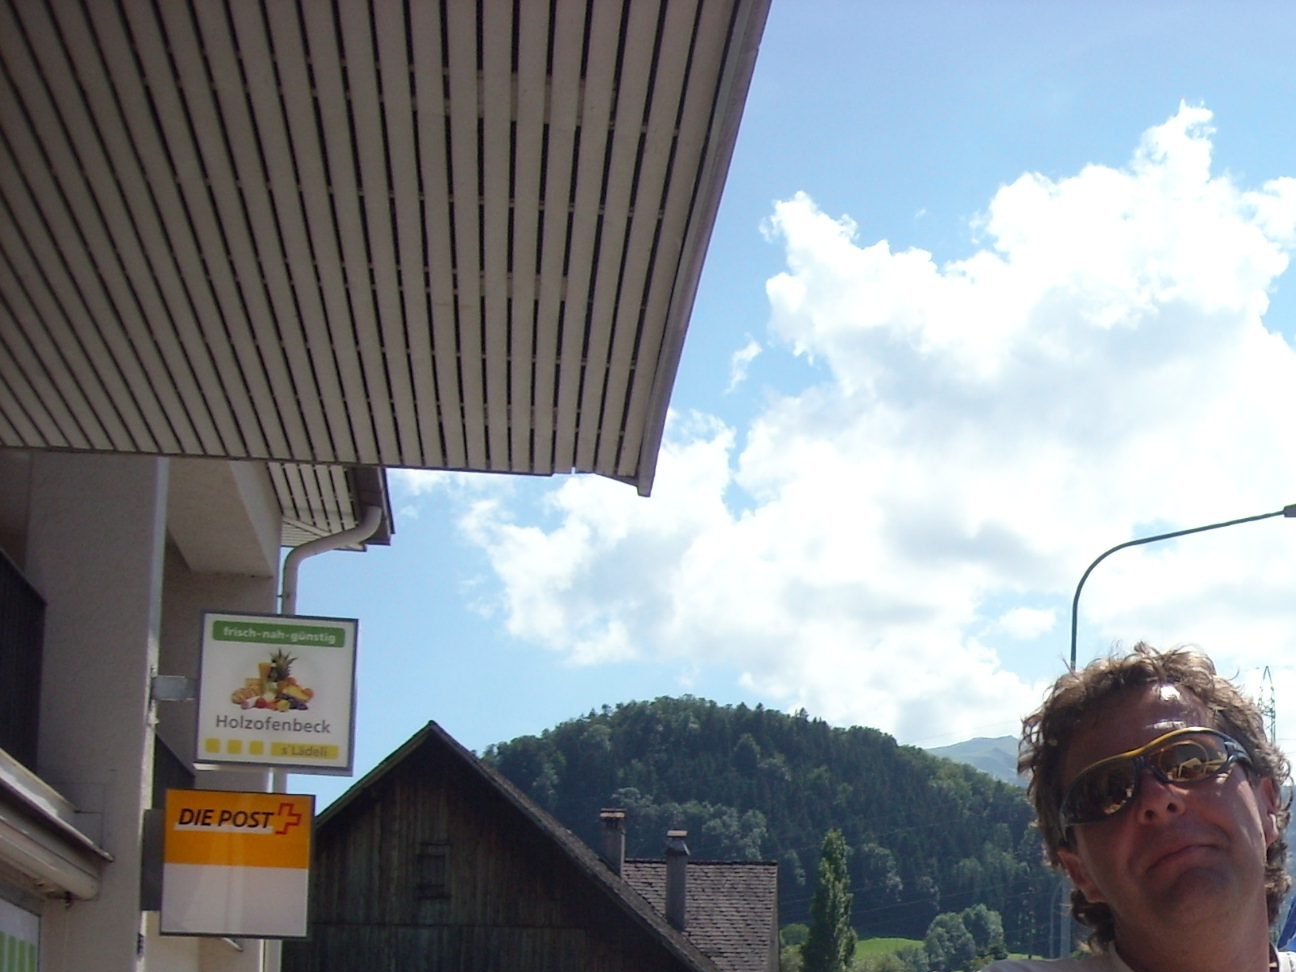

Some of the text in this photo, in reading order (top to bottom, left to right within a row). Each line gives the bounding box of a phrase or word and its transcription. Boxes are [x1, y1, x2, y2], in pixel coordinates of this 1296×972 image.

[216, 715, 331, 733] Holzofenbeck
[178, 808, 275, 829] DIE POST
